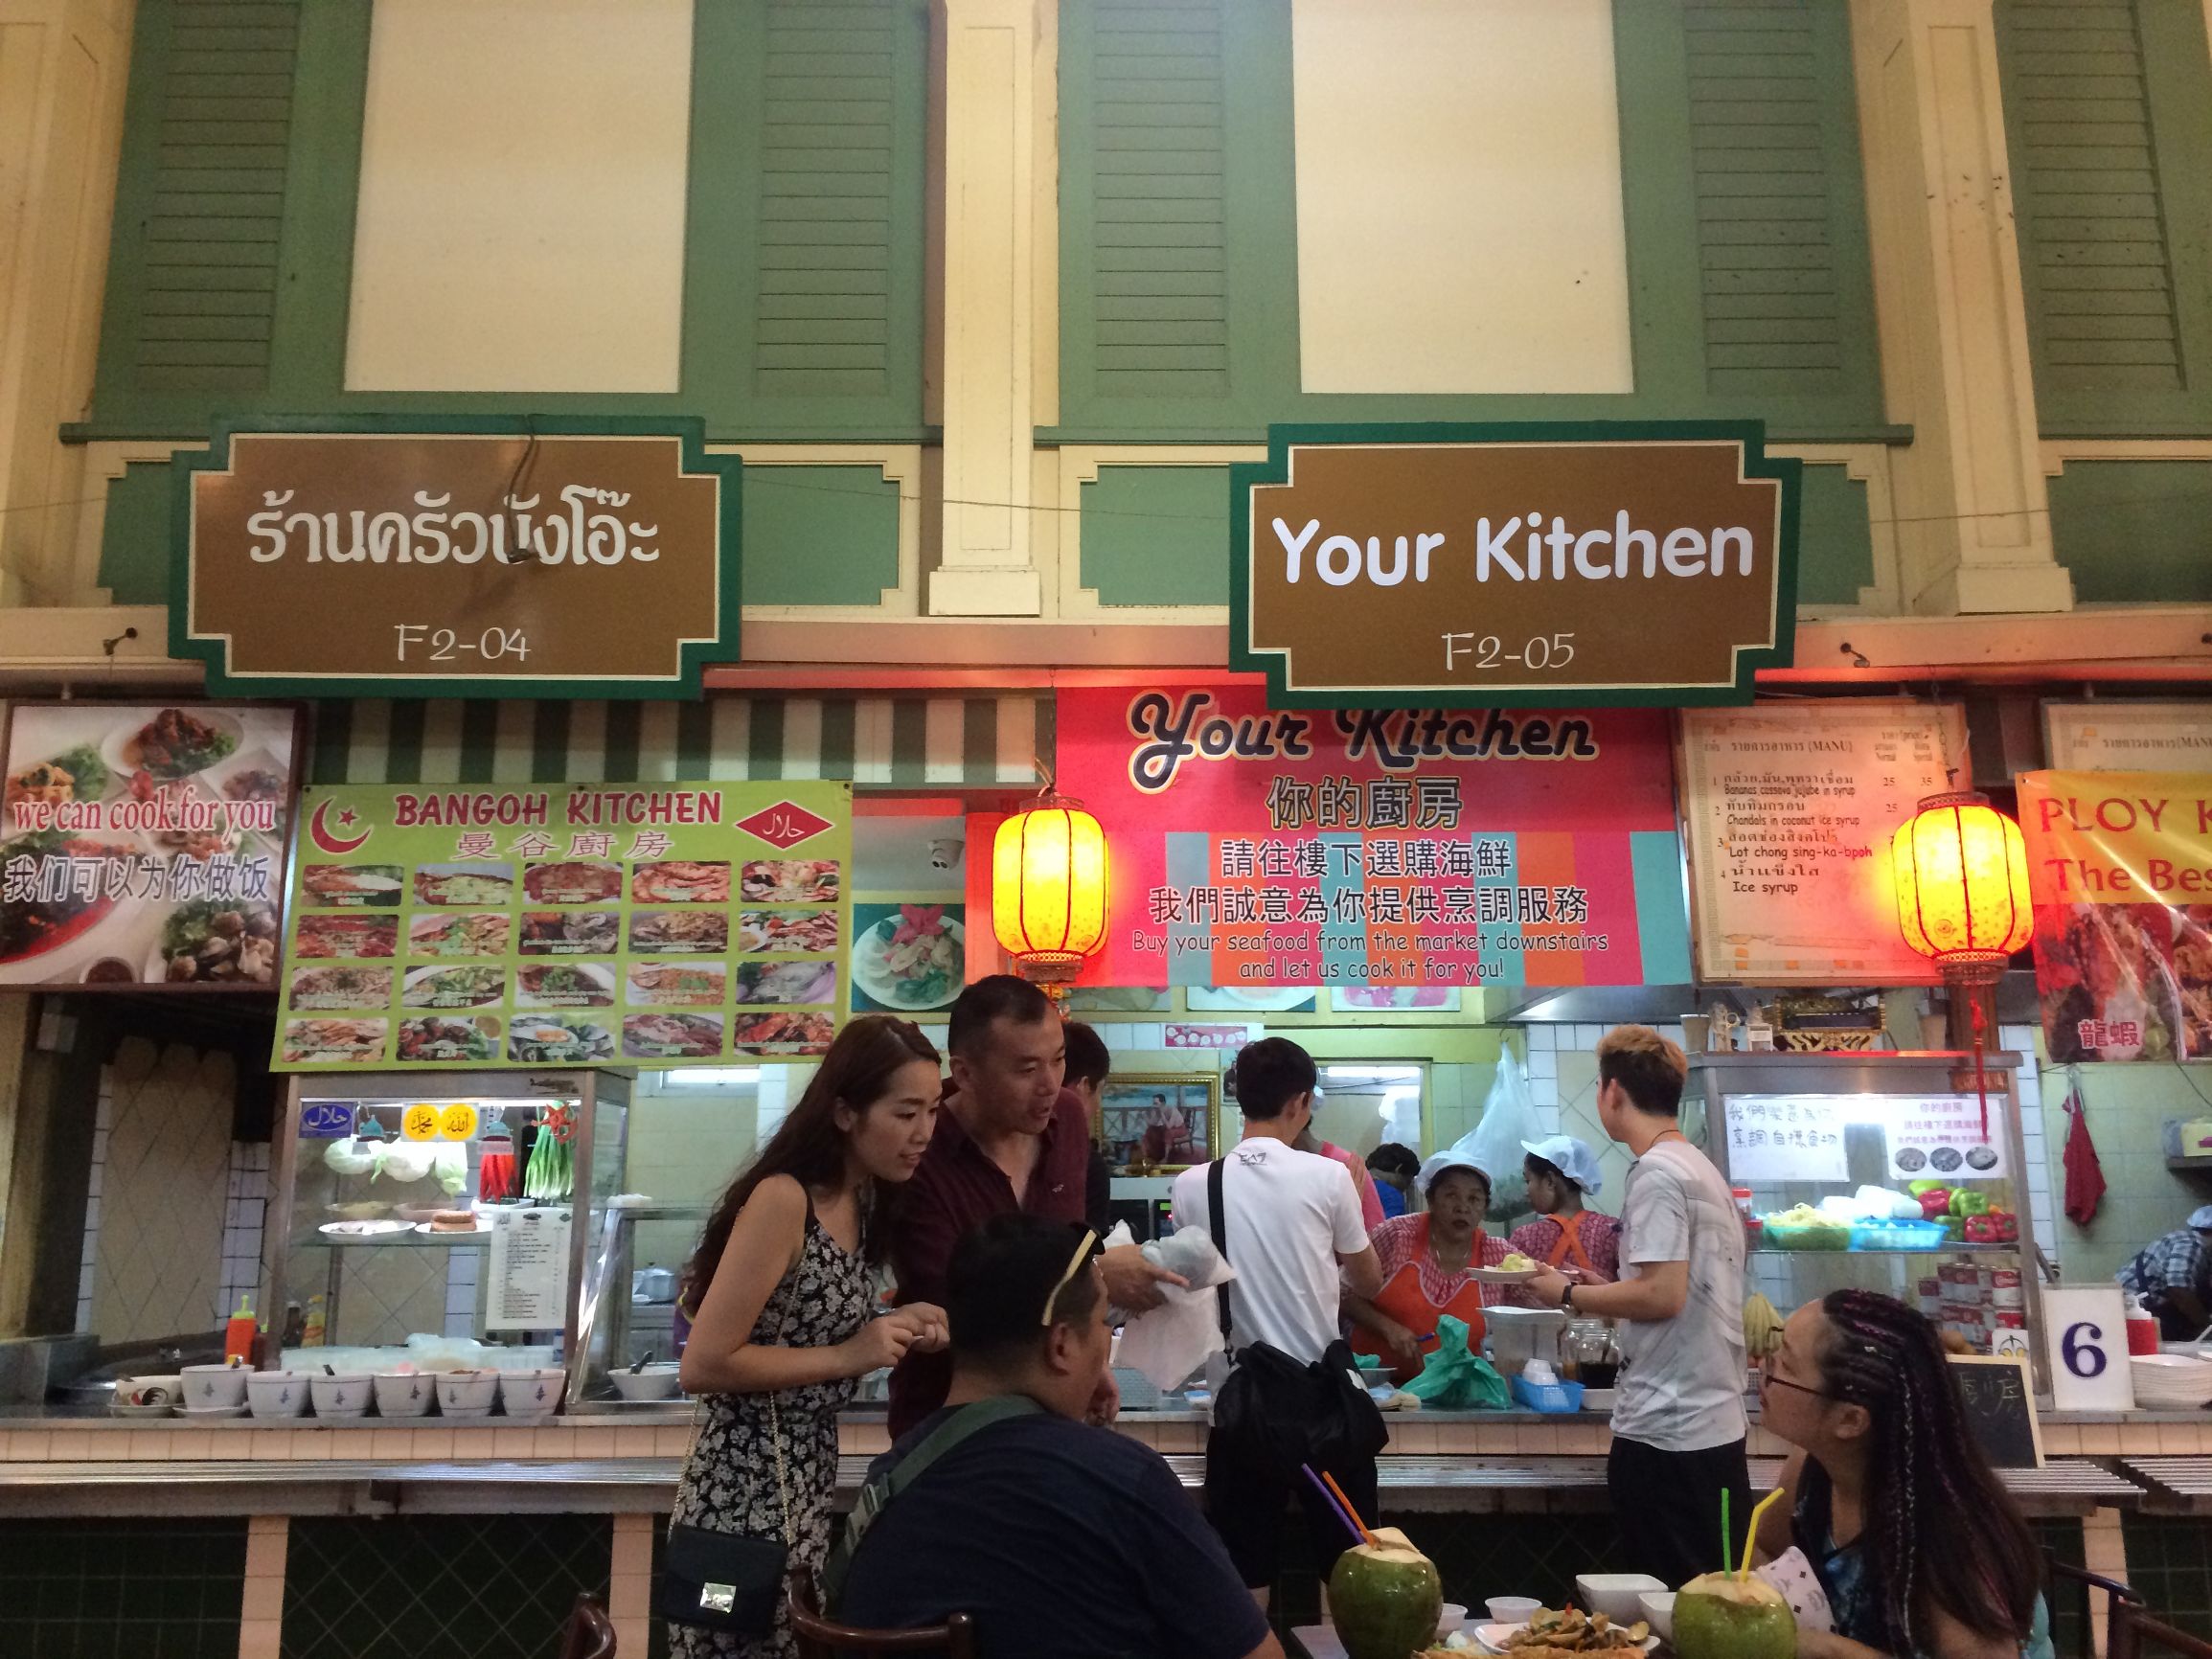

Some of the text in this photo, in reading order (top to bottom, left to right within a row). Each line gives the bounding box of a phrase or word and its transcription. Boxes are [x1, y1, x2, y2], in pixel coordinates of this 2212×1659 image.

[247, 485, 660, 565] ร้านครัวบังโอ๊ะ
[1272, 510, 1753, 586] Your Kitchen
[394, 624, 531, 661] F2-04
[1441, 632, 1575, 670] F2-05
[1129, 693, 1600, 792] Your Kitchen
[1882, 777, 1895, 786] 25
[1920, 777, 1932, 786] 35
[14, 785, 274, 844] we can cook for you
[395, 792, 721, 826] BANGOH KITCHEN
[1266, 776, 1464, 830] 你的廚房
[2039, 798, 2169, 832] PLOY
[763, 813, 806, 838] حلال
[1782, 815, 1814, 826] coconut
[452, 831, 673, 860] 曼谷廚房
[1221, 839, 1512, 878] 請往樓下選購海鮮
[1729, 846, 1749, 857] Lot
[1755, 846, 1788, 860] chong
[4, 854, 269, 901] 我们可以为你做饭
[1733, 881, 1799, 895] Ice syrup
[2044, 859, 2132, 892] The
[1151, 887, 1589, 925] 我們誠意為你提供烹調服務
[1133, 929, 1608, 956] Buy your seafood from the market downstairs
[1240, 957, 1504, 984] and let us cook it for you!
[2079, 1020, 2140, 1048] 龍蝦
[308, 1105, 348, 1126] حلال
[2062, 1323, 2107, 1378] 6
